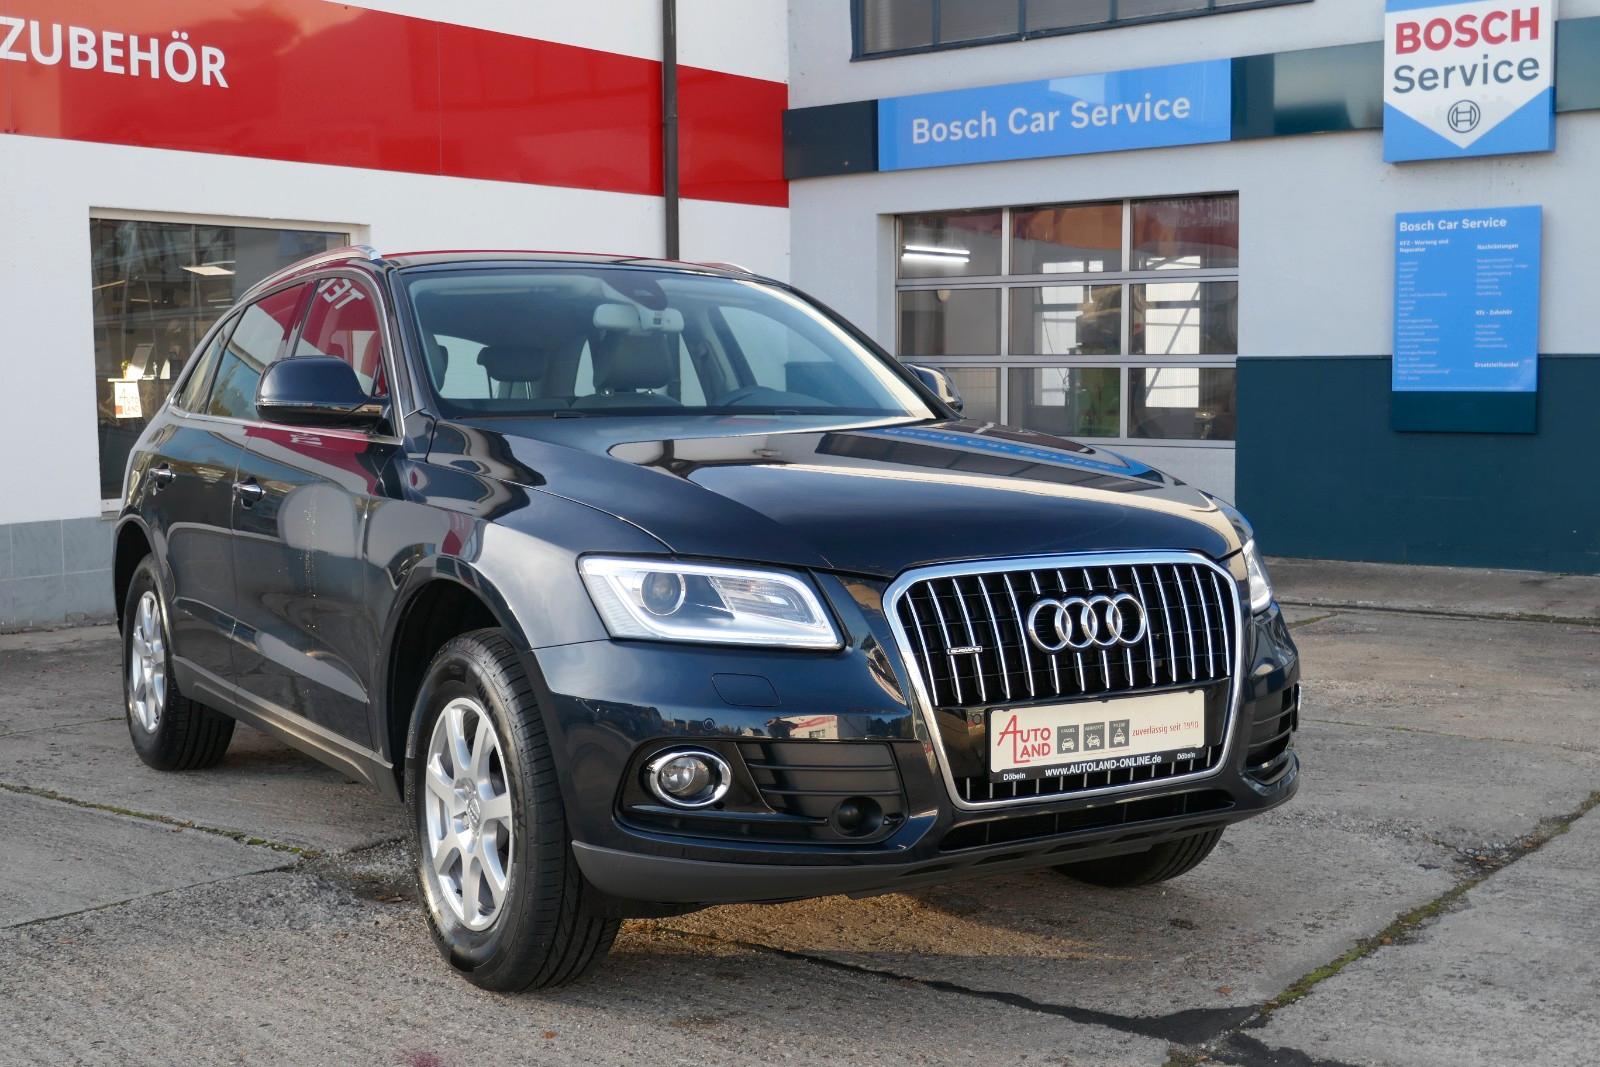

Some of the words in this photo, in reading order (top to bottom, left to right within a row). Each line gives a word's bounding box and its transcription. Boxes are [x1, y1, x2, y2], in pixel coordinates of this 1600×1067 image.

[1396, 7, 1539, 55] BOSCH
[0, 16, 229, 88] ZUBEHÖR
[1393, 53, 1540, 94] Service
[912, 110, 997, 144] Bosch
[1008, 106, 1060, 134] Car
[1071, 93, 1191, 129] Service
[1399, 220, 1434, 232] Bosch
[1437, 219, 1458, 230] Car
[1461, 217, 1507, 229] Service
[997, 715, 1051, 746] AUTO
[1003, 772, 1026, 781] Döbeln
[1045, 754, 1162, 777] www.AUTOLAND-ONLINE.de
